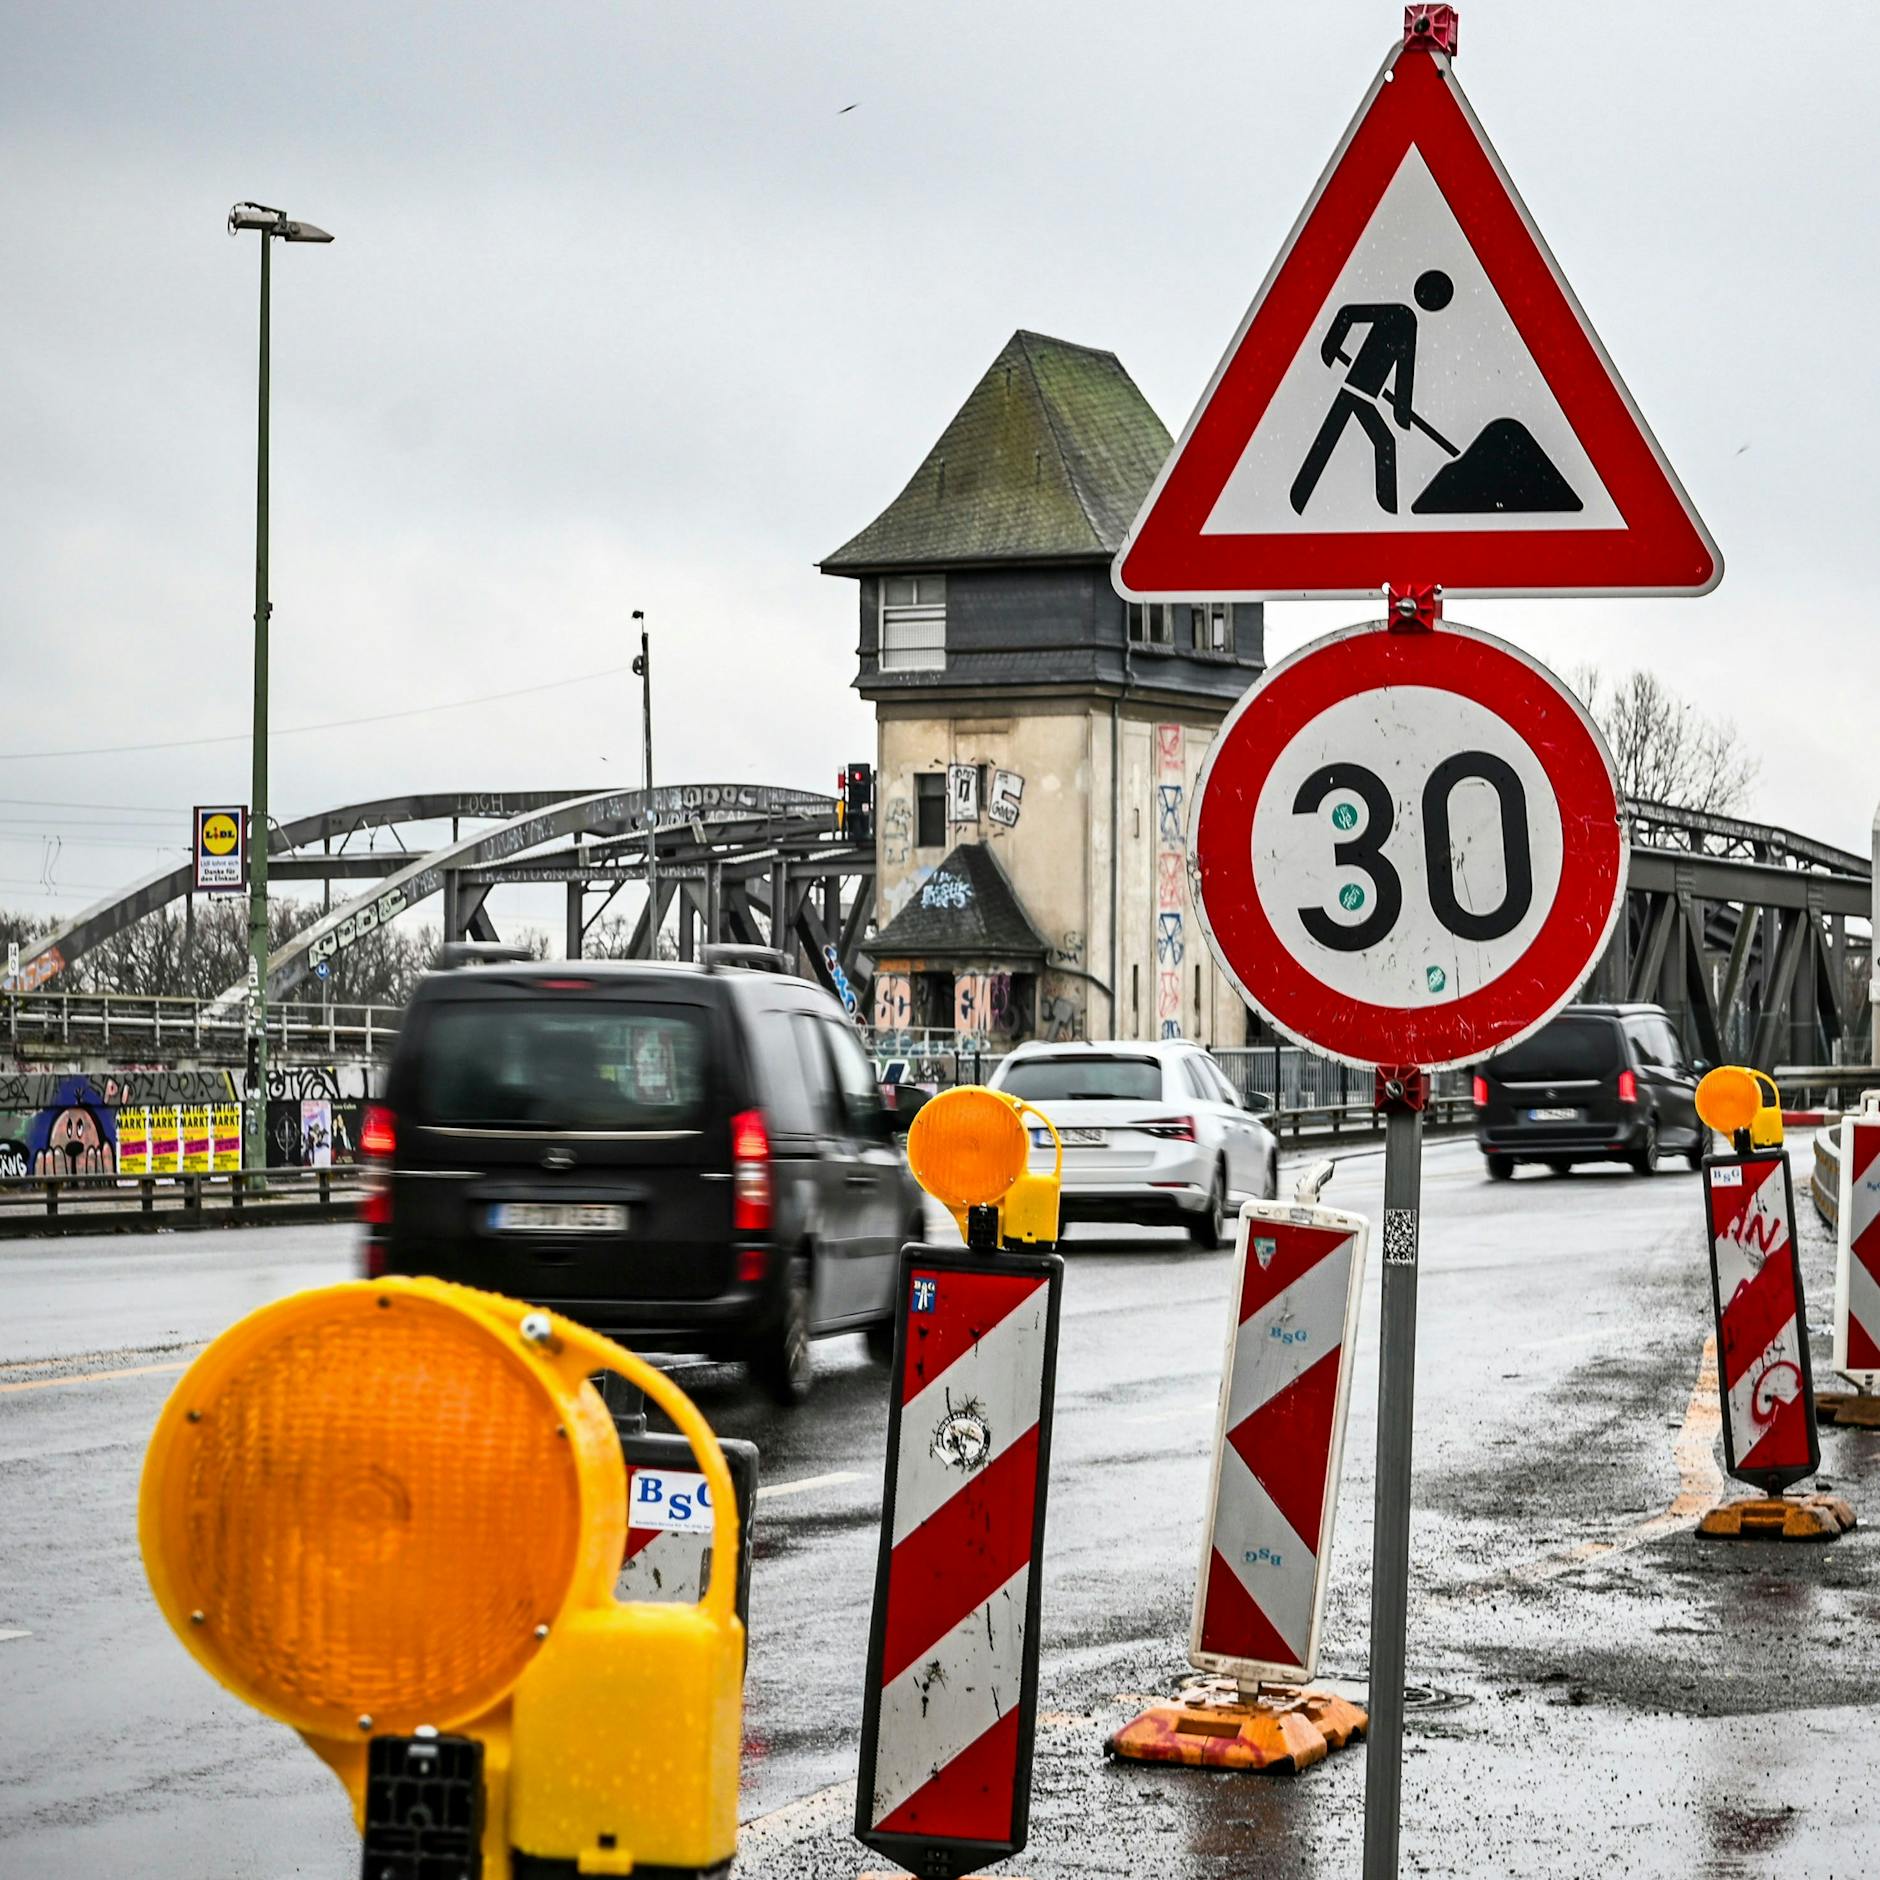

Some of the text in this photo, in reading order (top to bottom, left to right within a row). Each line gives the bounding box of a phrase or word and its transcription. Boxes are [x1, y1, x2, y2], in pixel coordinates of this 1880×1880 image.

[1291, 751, 1533, 952] 30
[116, 1117, 147, 1129] MARKT
[148, 1116, 178, 1128] MARKT
[180, 1116, 209, 1128] MARKT
[211, 1114, 240, 1126] MARKT
[1713, 1169, 1739, 1183] BSG
[1269, 1327, 1308, 1344] BSG
[1246, 1548, 1281, 1566] BSG
